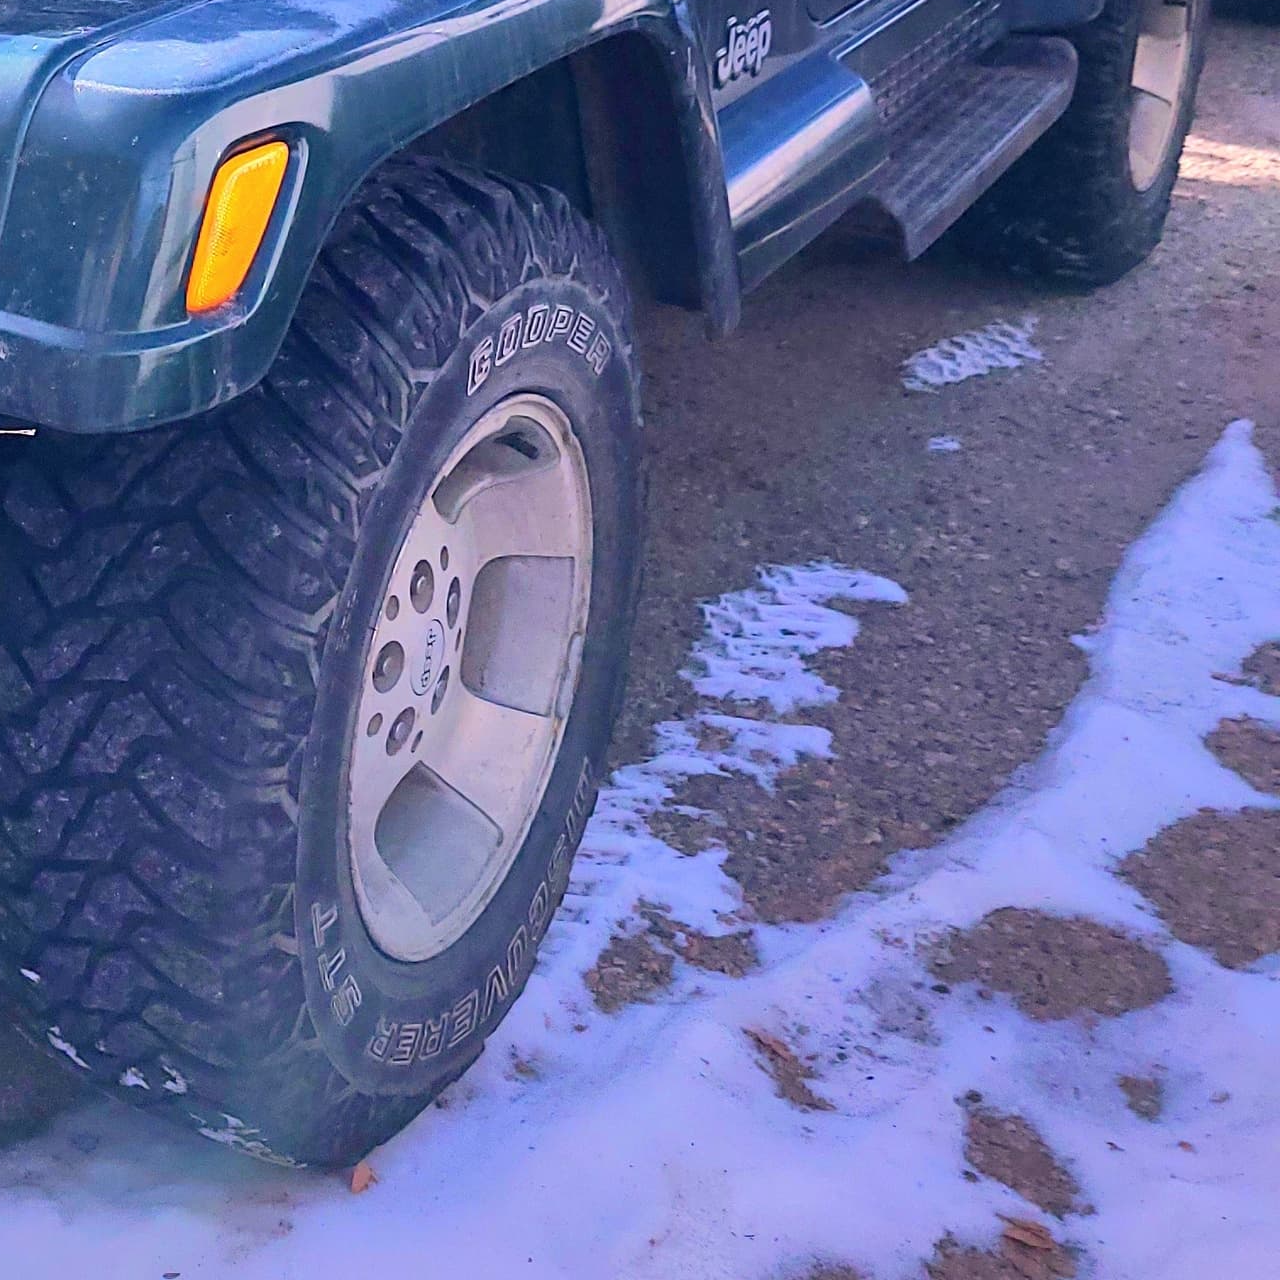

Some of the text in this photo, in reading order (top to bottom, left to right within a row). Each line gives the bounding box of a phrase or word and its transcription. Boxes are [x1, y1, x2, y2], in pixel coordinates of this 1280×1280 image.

[715, 9, 771, 82] Jeep
[467, 304, 613, 396] COOPER
[310, 901, 363, 1027] STT
